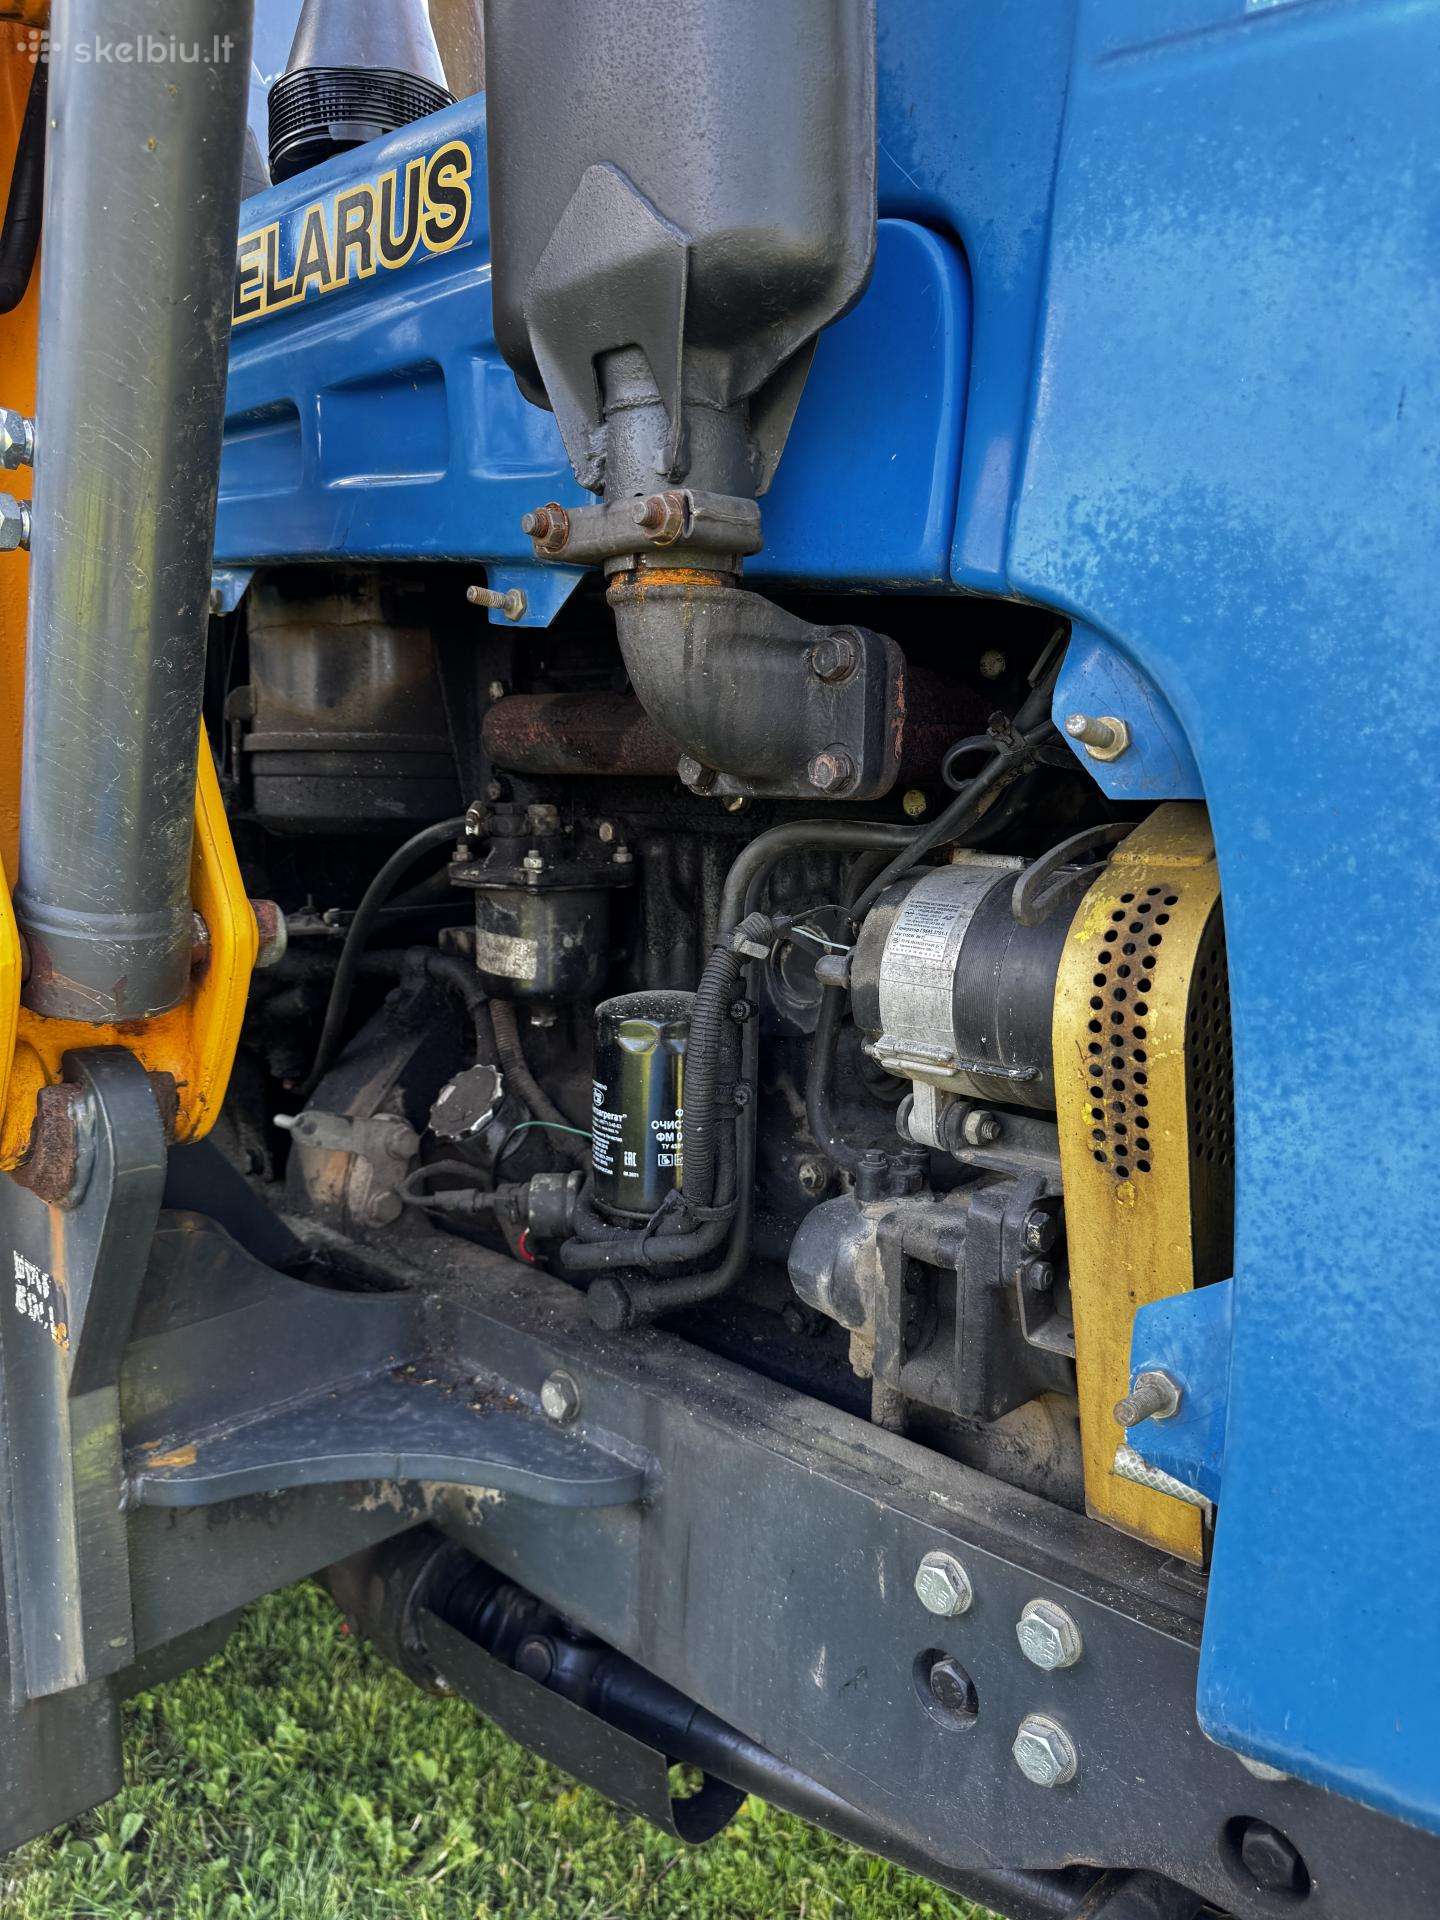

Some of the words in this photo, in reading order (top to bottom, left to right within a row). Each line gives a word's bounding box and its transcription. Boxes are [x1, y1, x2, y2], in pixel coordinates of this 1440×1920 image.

[232, 140, 472, 326] ELARUS
[650, 1119, 684, 1130] ОЧИС
[655, 1131, 675, 1142] ФМ
